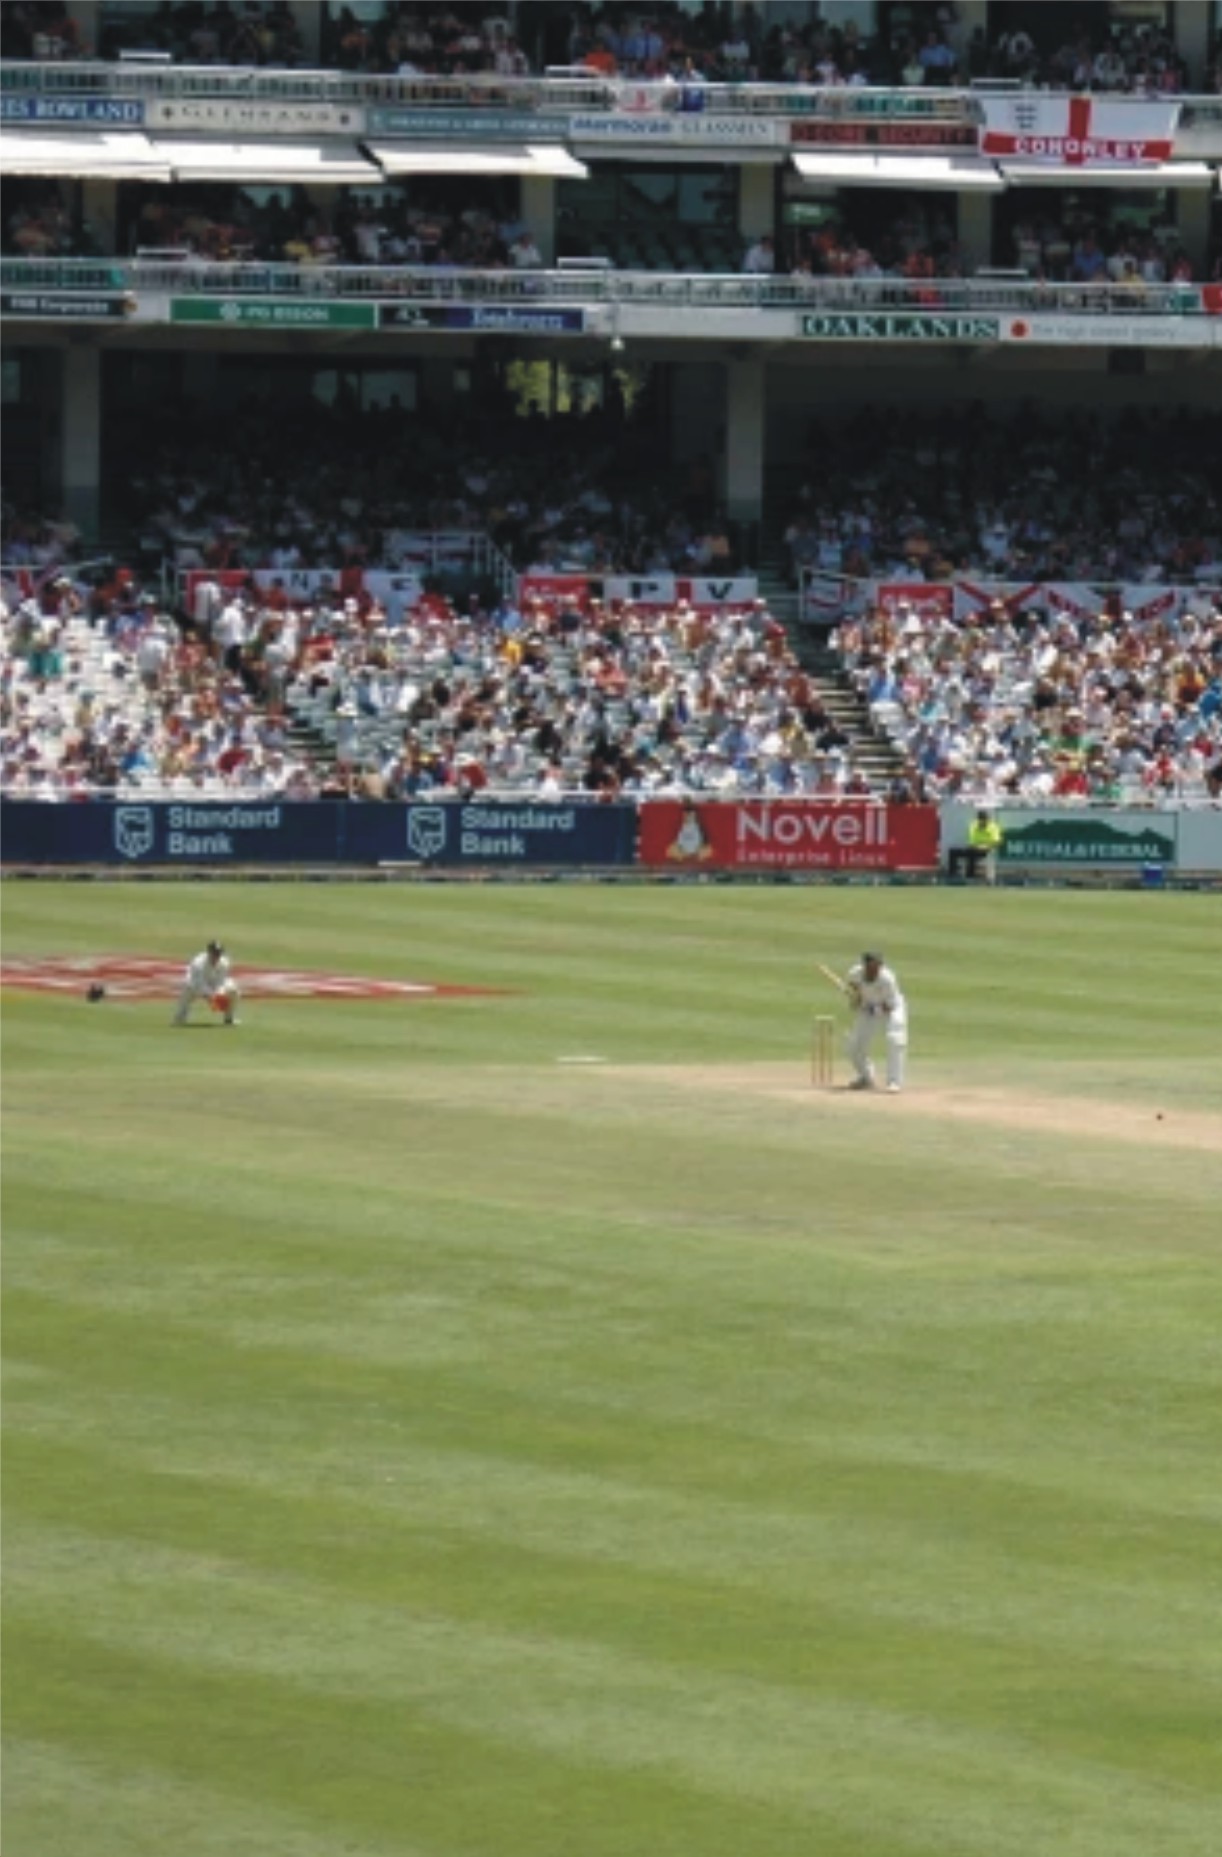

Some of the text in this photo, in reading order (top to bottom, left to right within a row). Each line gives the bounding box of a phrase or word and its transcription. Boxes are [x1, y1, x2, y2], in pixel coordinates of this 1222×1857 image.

[35, 100, 139, 120] ROWLAND
[803, 315, 997, 338] OAKLANDS
[168, 806, 280, 829] Standard
[460, 807, 575, 830] Standard
[736, 802, 888, 846] Novell
[168, 832, 234, 855] Bank
[460, 833, 525, 856] Bank
